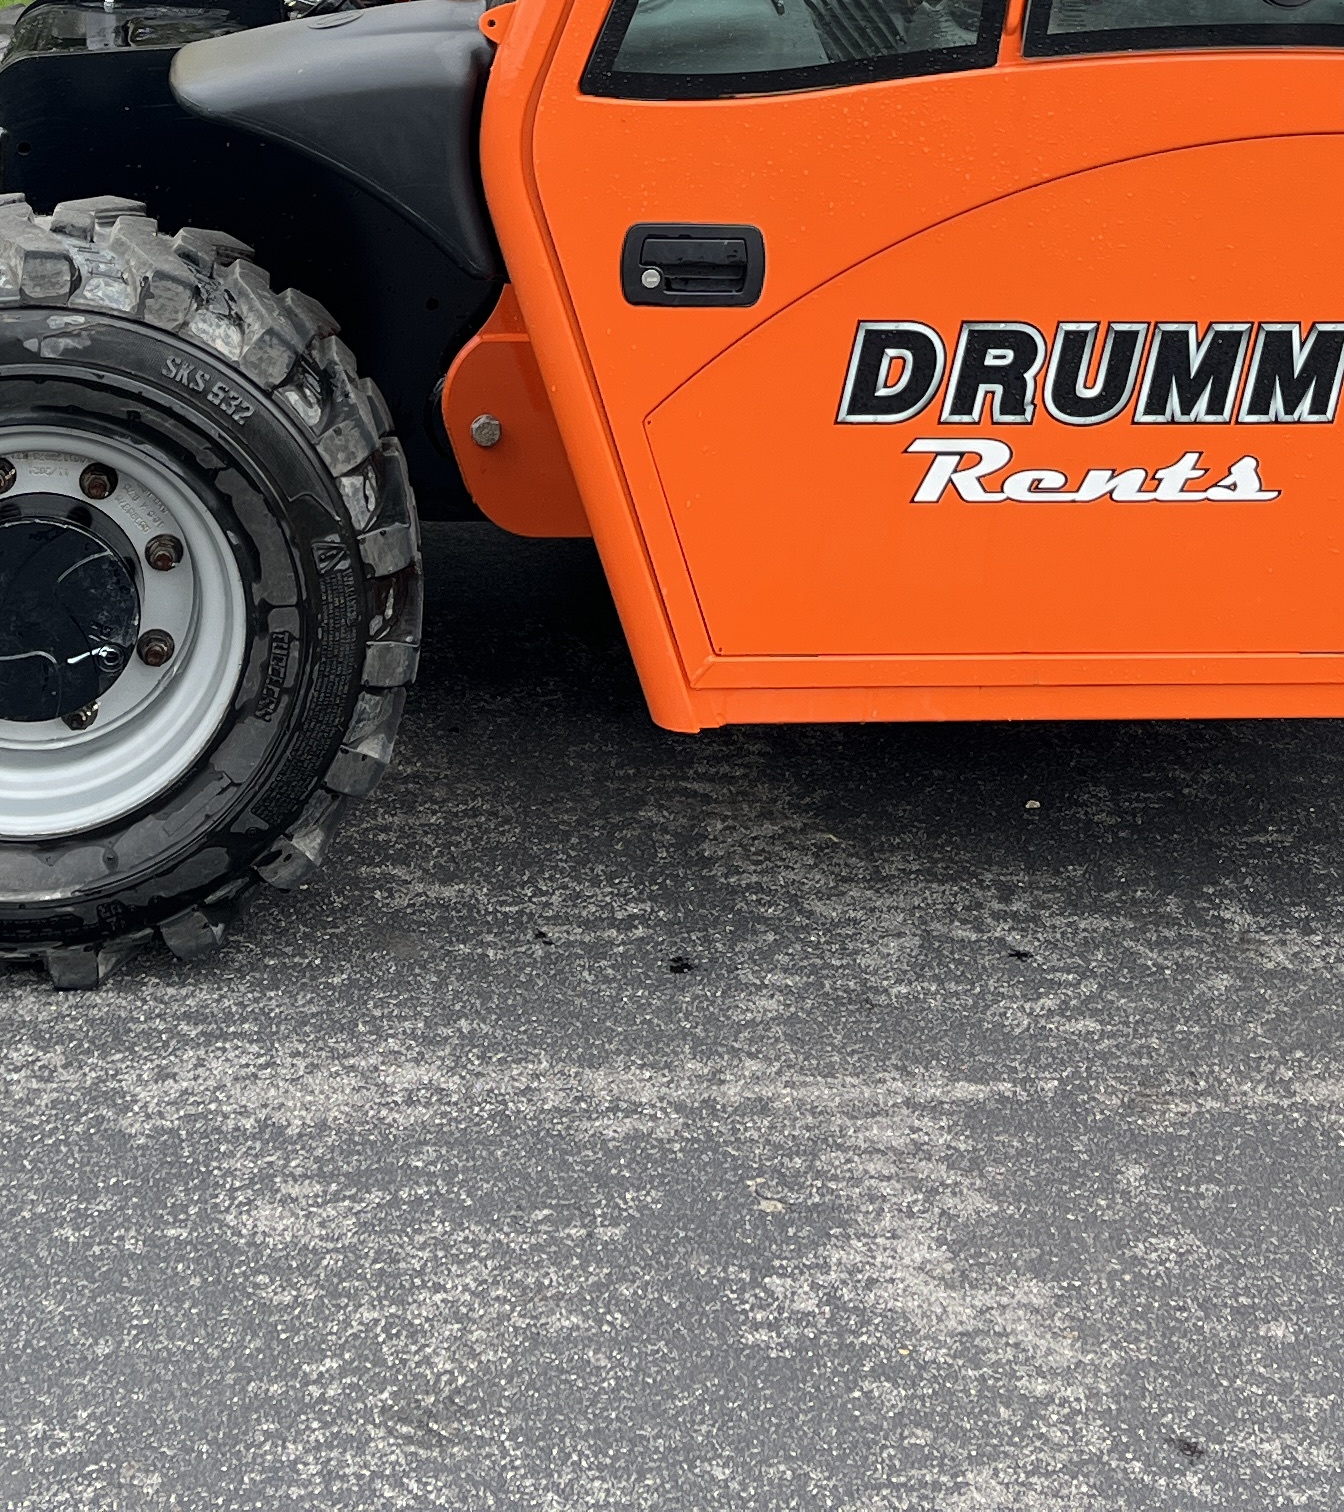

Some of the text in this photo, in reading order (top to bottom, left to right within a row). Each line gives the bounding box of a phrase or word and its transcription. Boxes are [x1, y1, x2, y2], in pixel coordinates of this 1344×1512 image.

[161, 355, 255, 426] SKS 532
[902, 437, 1283, 504] Rents
